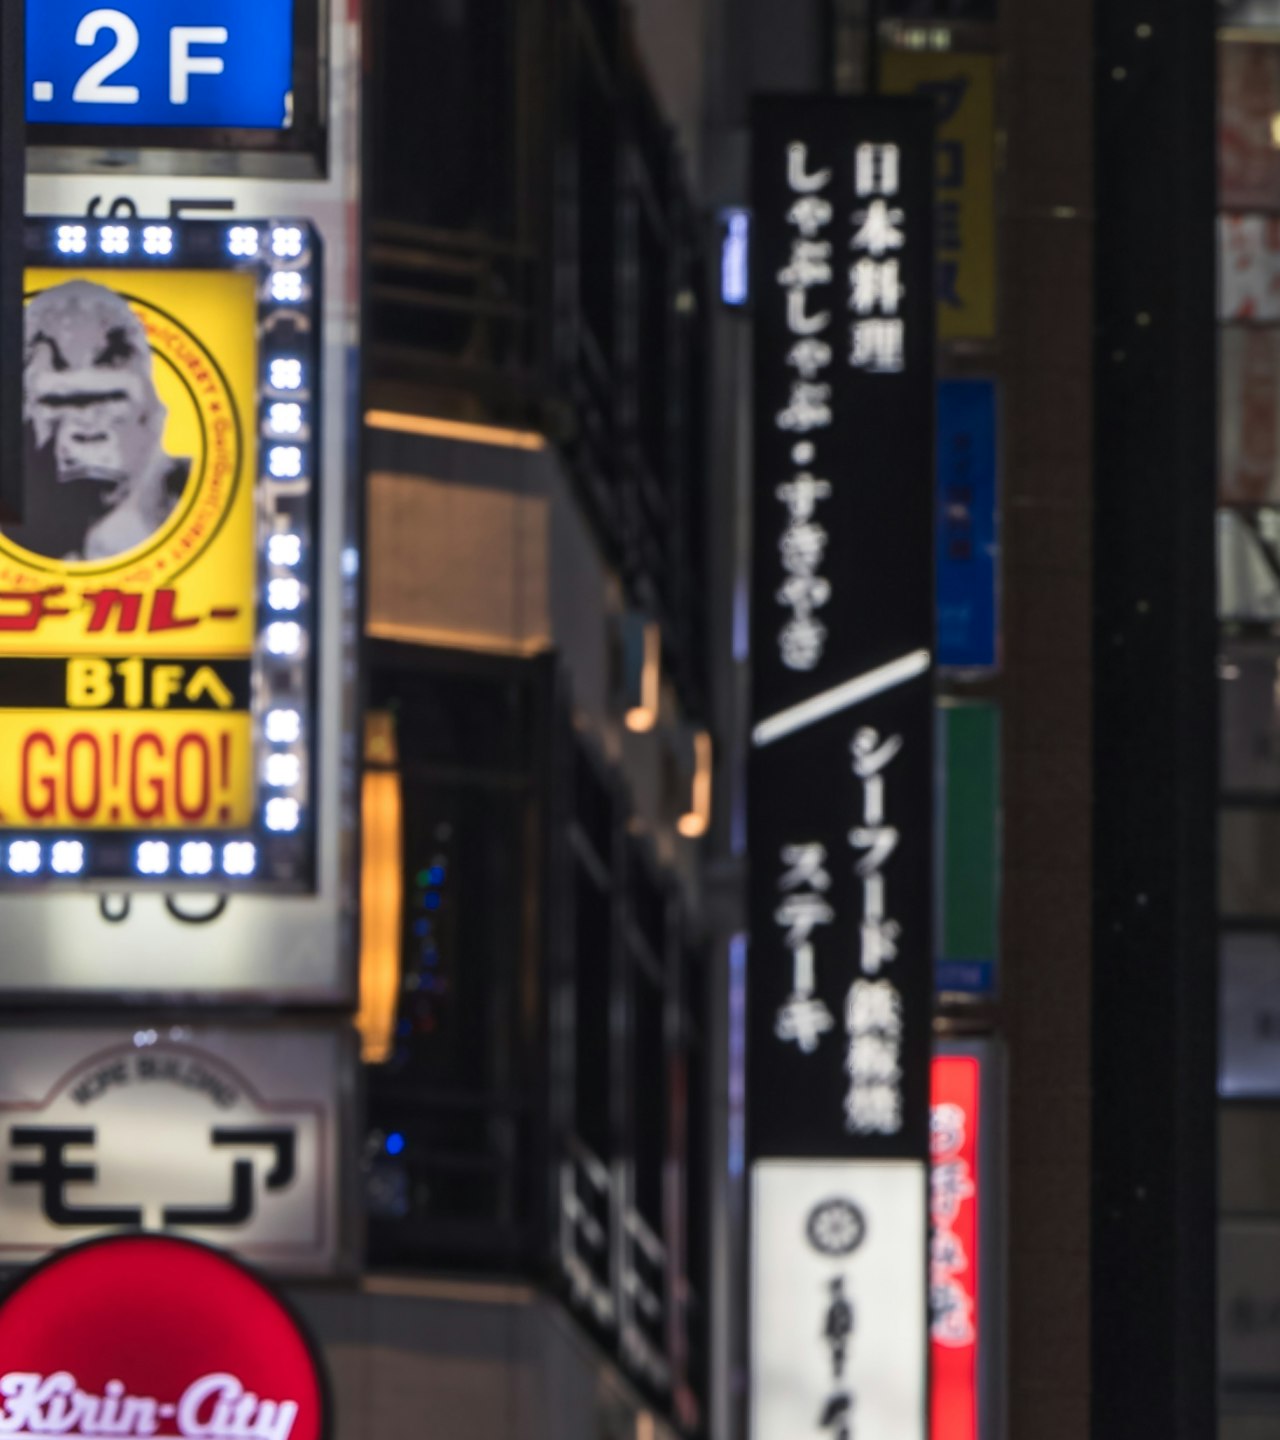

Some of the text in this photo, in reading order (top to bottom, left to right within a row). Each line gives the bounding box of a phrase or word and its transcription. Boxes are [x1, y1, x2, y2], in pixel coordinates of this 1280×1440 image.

[849, 140, 906, 375] 日本料理
[65, 656, 235, 710] B1Fへ
[20, 730, 231, 822] GO!GO!
[772, 840, 836, 1057] ステーキ
[10, 1125, 296, 1225] モア
